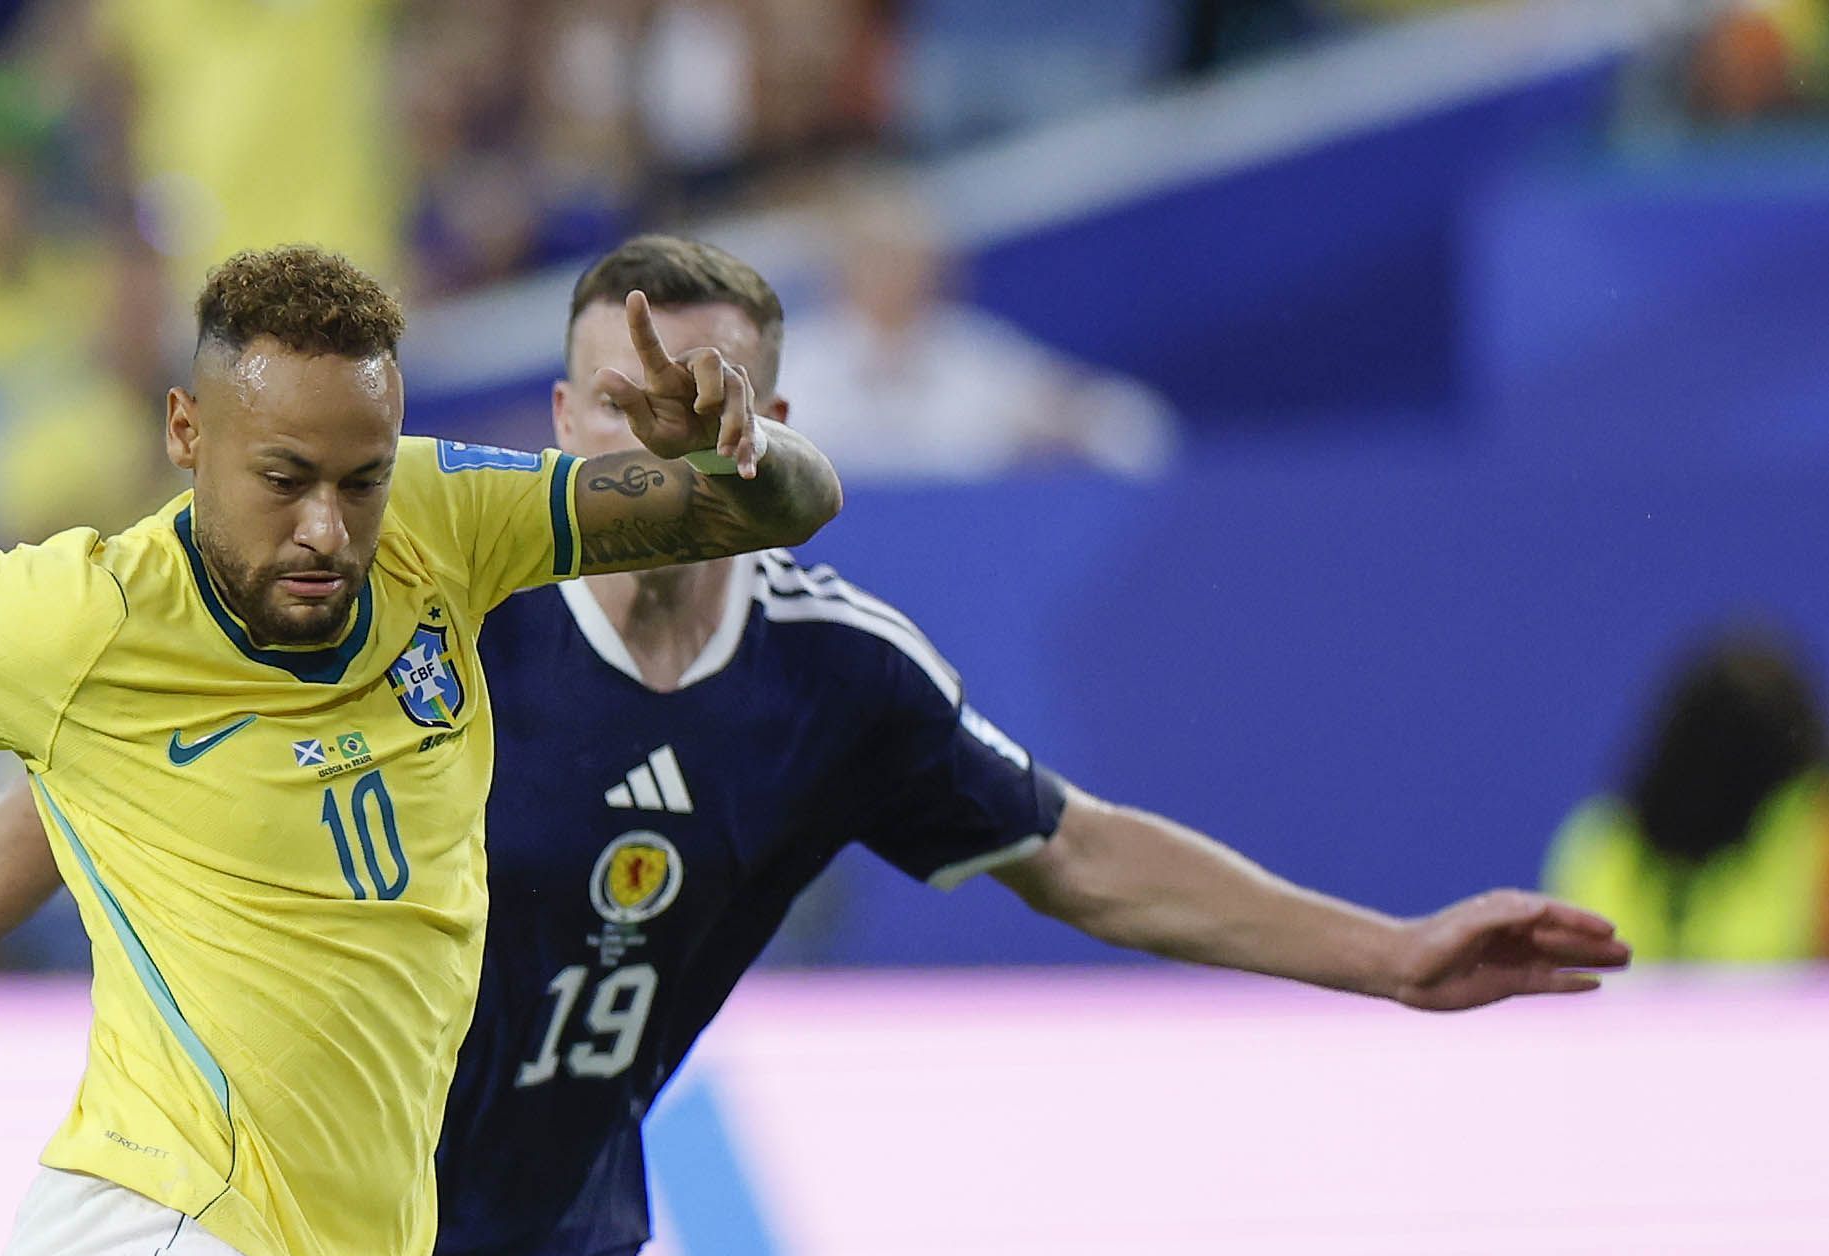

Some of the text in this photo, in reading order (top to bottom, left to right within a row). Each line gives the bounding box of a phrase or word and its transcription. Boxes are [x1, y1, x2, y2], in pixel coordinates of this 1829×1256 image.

[410, 662, 435, 685] CBF
[322, 769, 409, 900] 10
[514, 963, 659, 1088] 19
